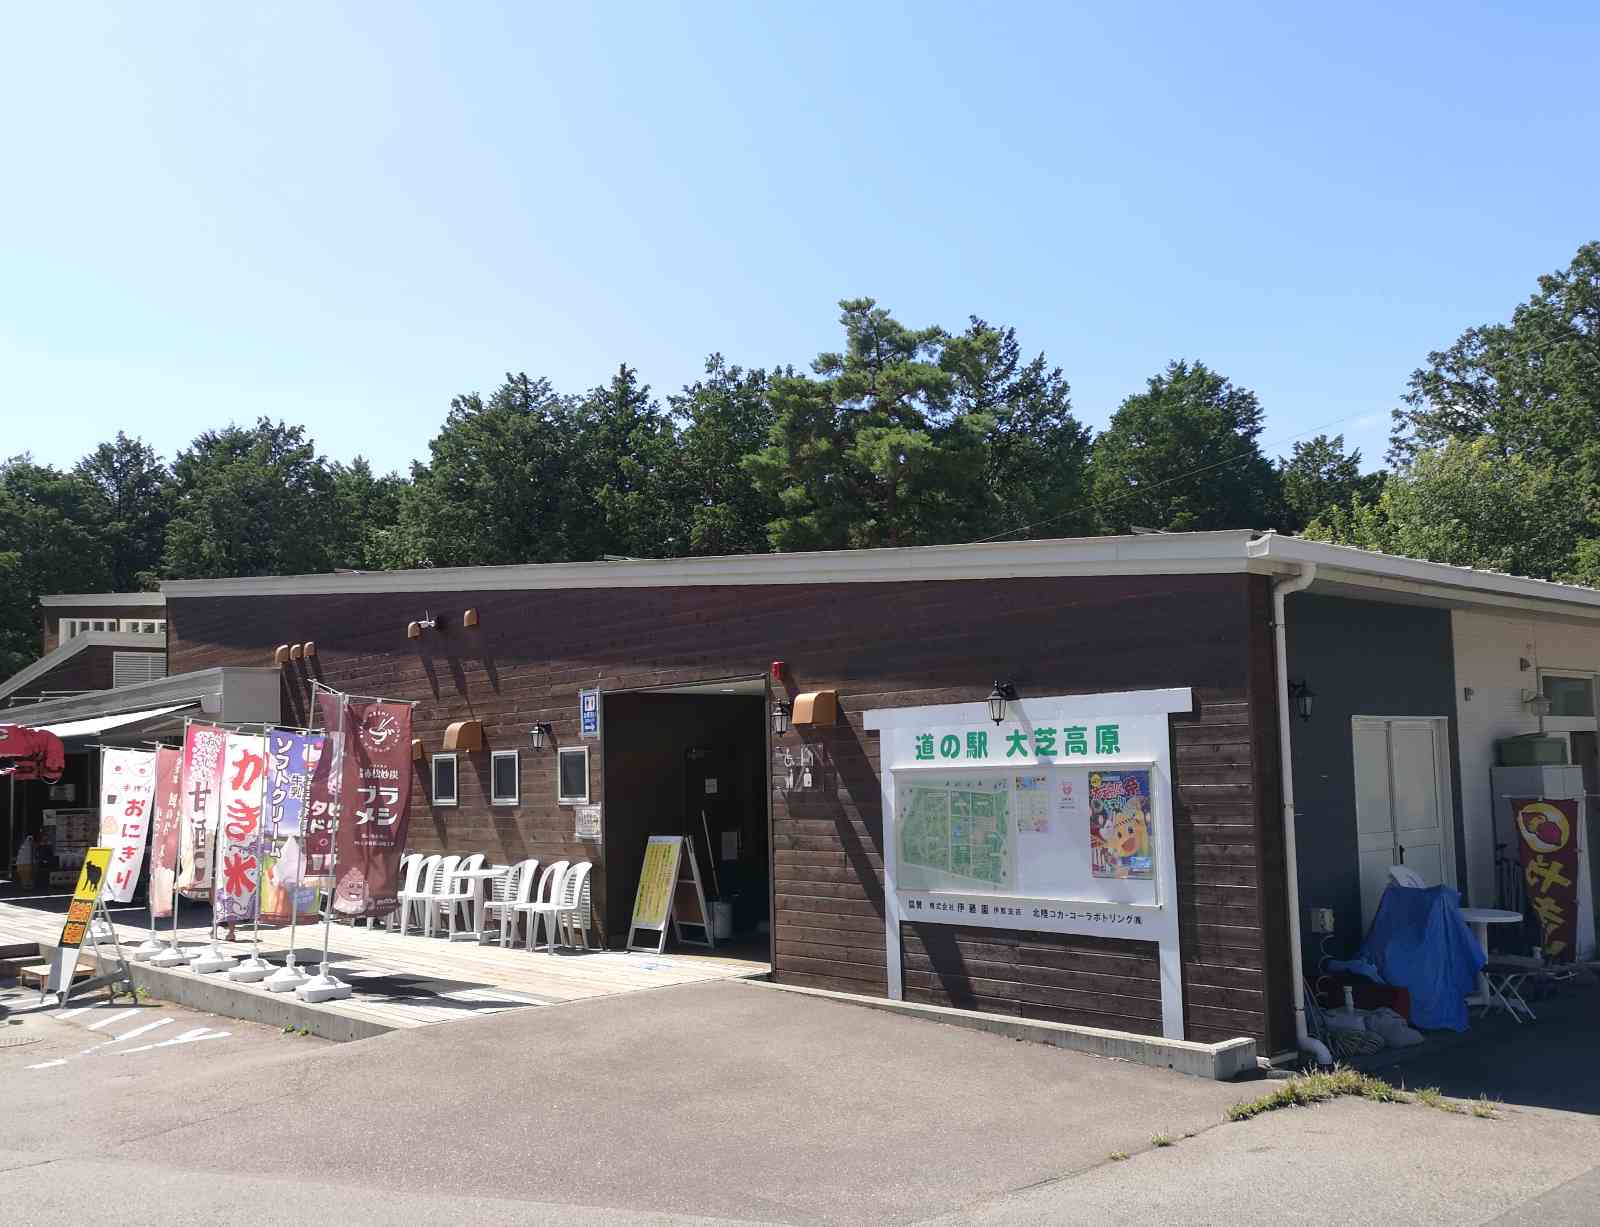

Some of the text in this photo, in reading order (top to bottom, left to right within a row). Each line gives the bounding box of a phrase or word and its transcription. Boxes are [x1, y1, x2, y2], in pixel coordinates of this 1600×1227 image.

[915, 724, 1121, 760] 道の駅 大芝高原
[271, 737, 293, 858] ソフトクリーム
[356, 785, 399, 805] ブラ
[354, 807, 398, 825] メシ
